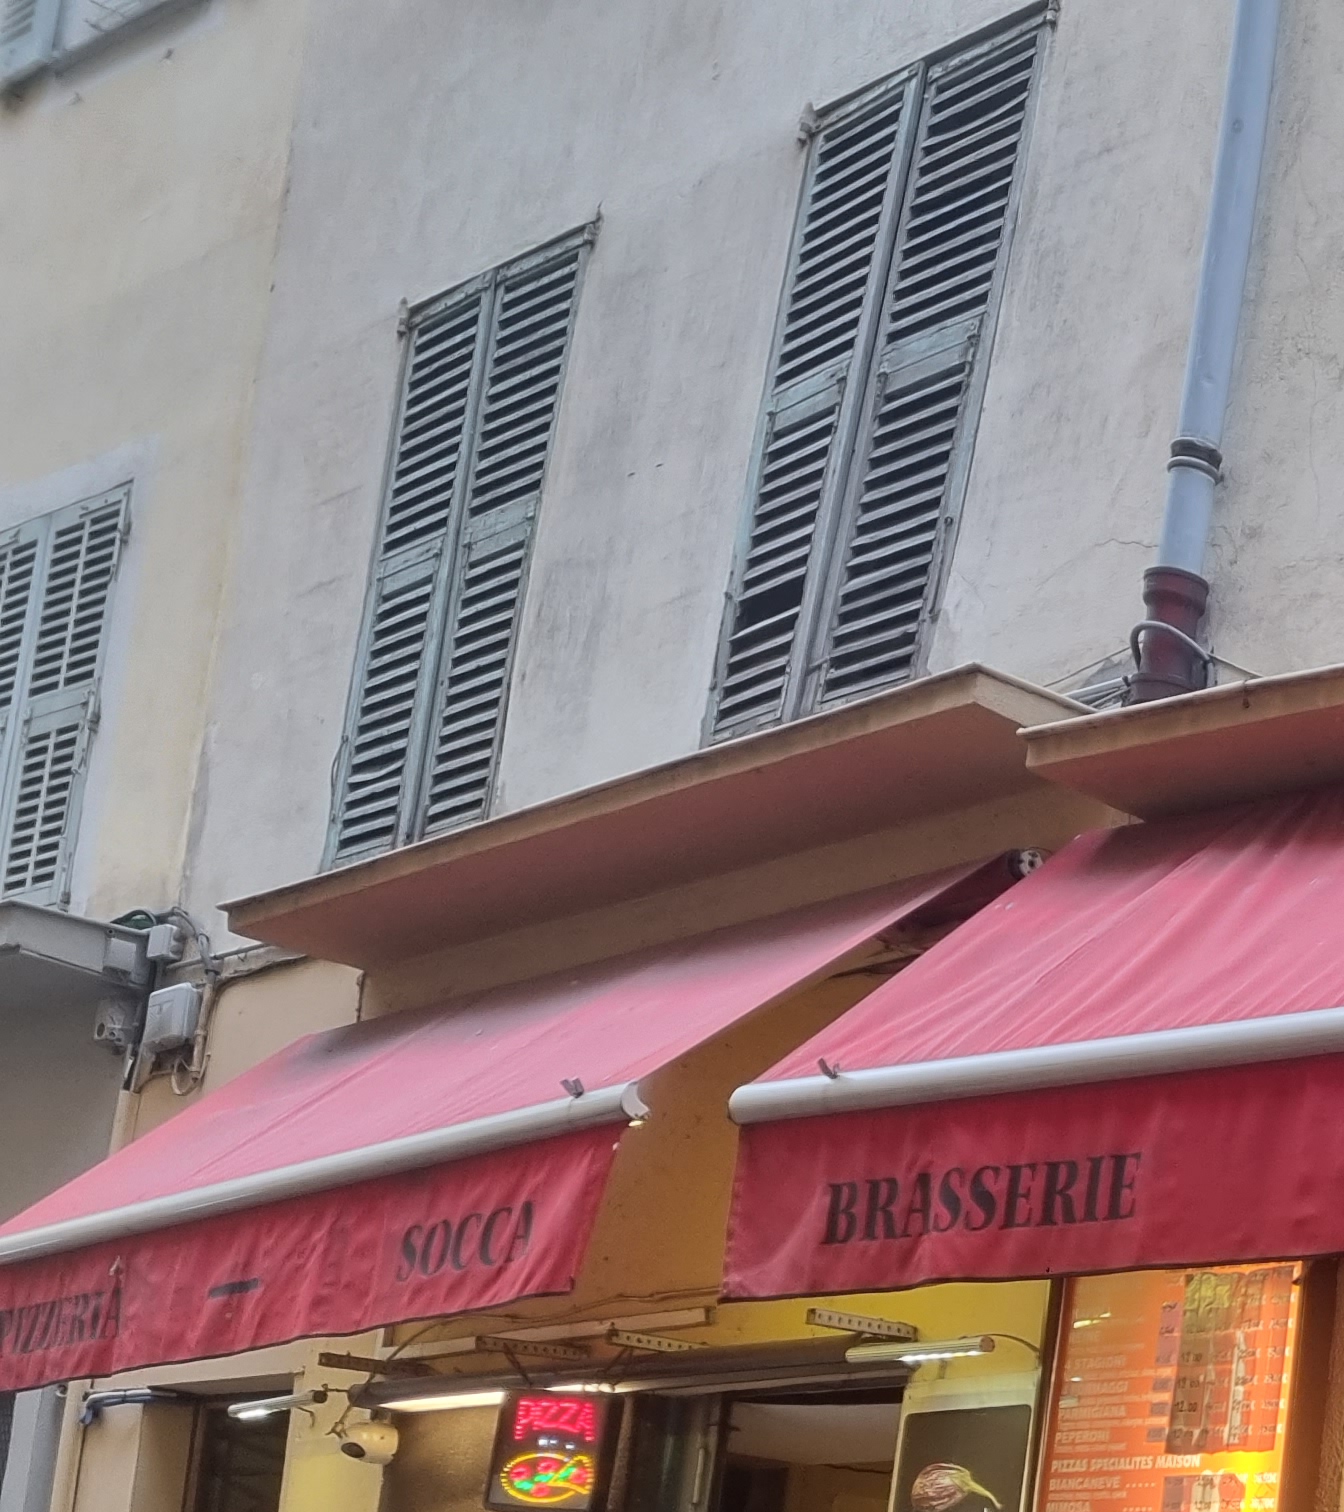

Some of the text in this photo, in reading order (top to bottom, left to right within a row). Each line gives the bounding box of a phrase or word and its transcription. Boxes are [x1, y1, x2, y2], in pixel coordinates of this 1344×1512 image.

[820, 1151, 1142, 1246] BRASSERIE
[398, 1200, 535, 1283] SOCCA
[515, 1400, 594, 1440] PIZZA
[1051, 1459, 1088, 1472] PIZZAS
[1155, 1454, 1200, 1468] MAISON
[1049, 1476, 1120, 1490] BIANCANEVE
[1046, 1501, 1090, 1512] MIMOSA
